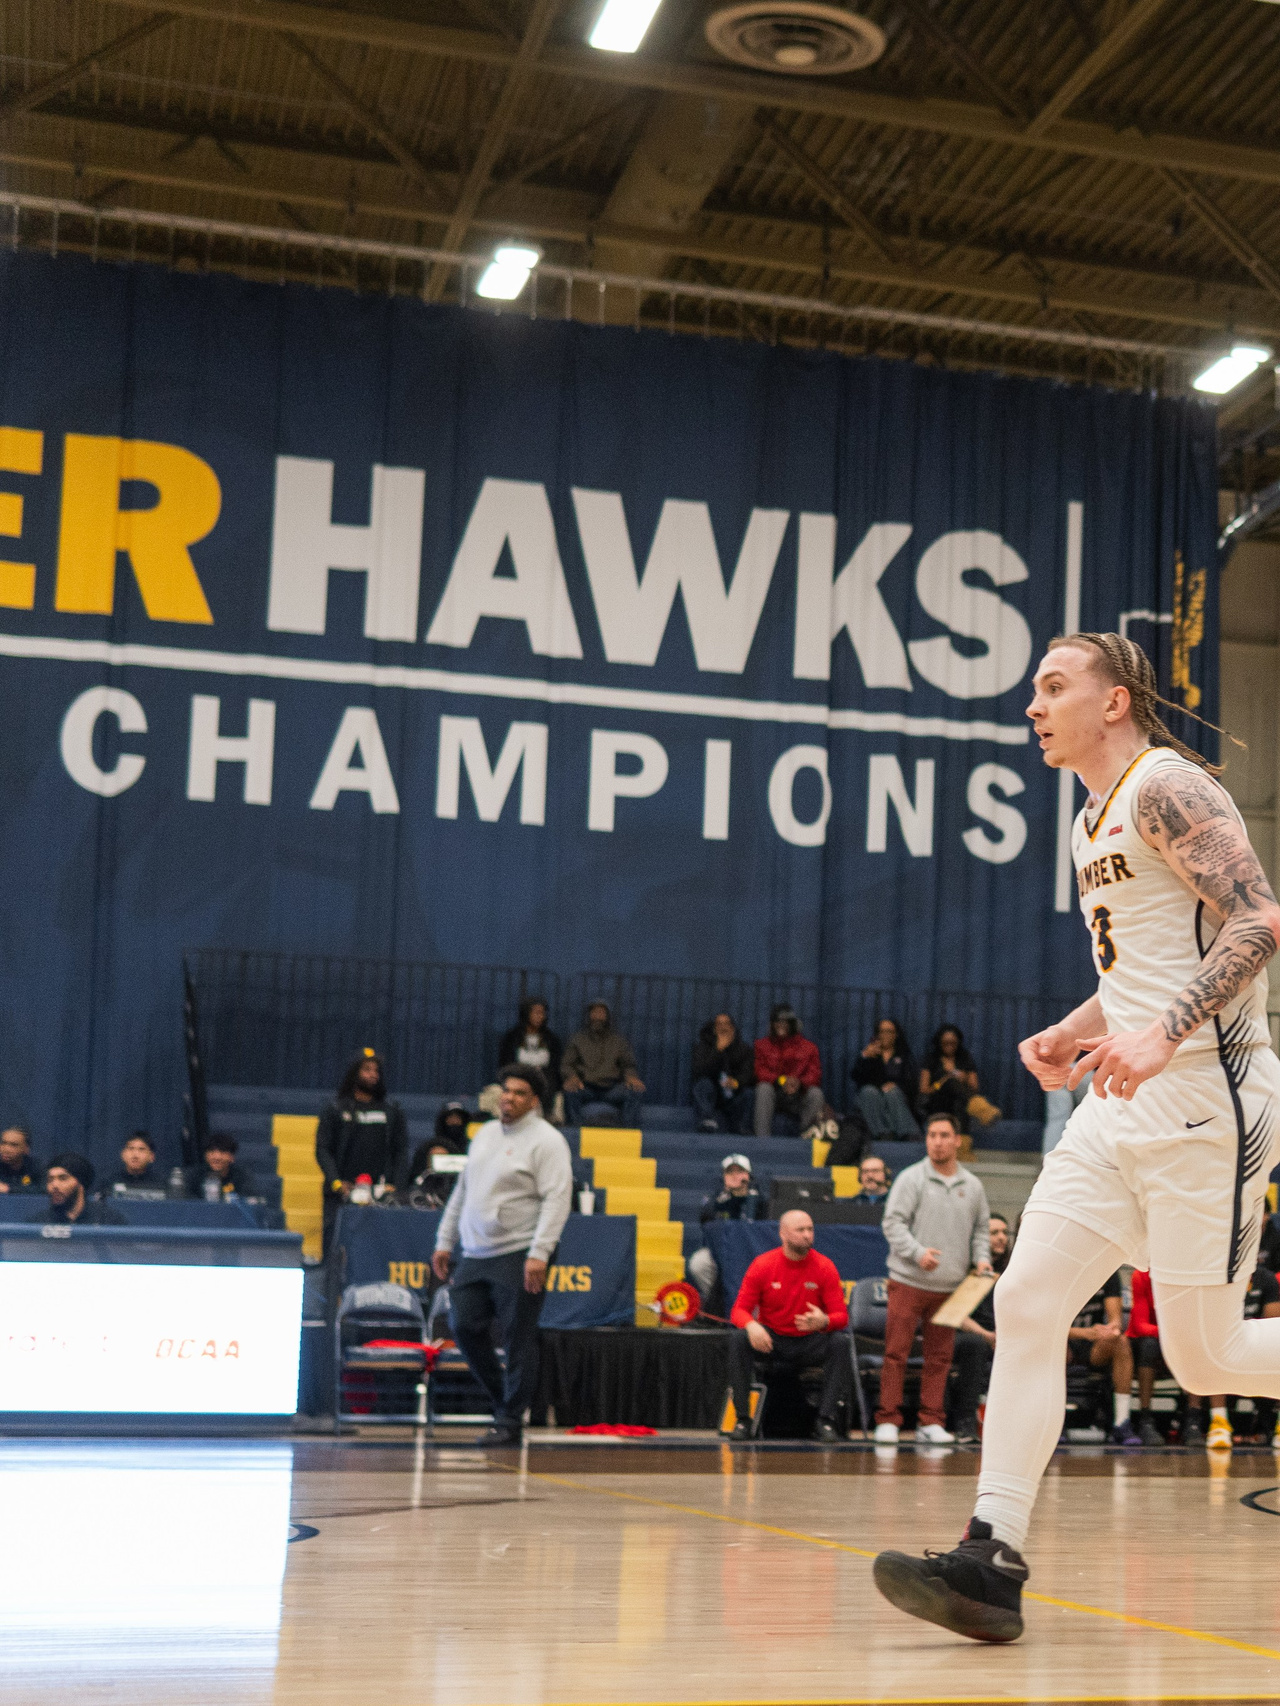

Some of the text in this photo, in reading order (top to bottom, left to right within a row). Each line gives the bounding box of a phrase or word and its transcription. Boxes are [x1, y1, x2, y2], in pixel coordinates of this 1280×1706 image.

[267, 455, 1032, 699] HAWKS
[60, 685, 1027, 864] CHAMPIONS
[1092, 904, 1117, 973] 3
